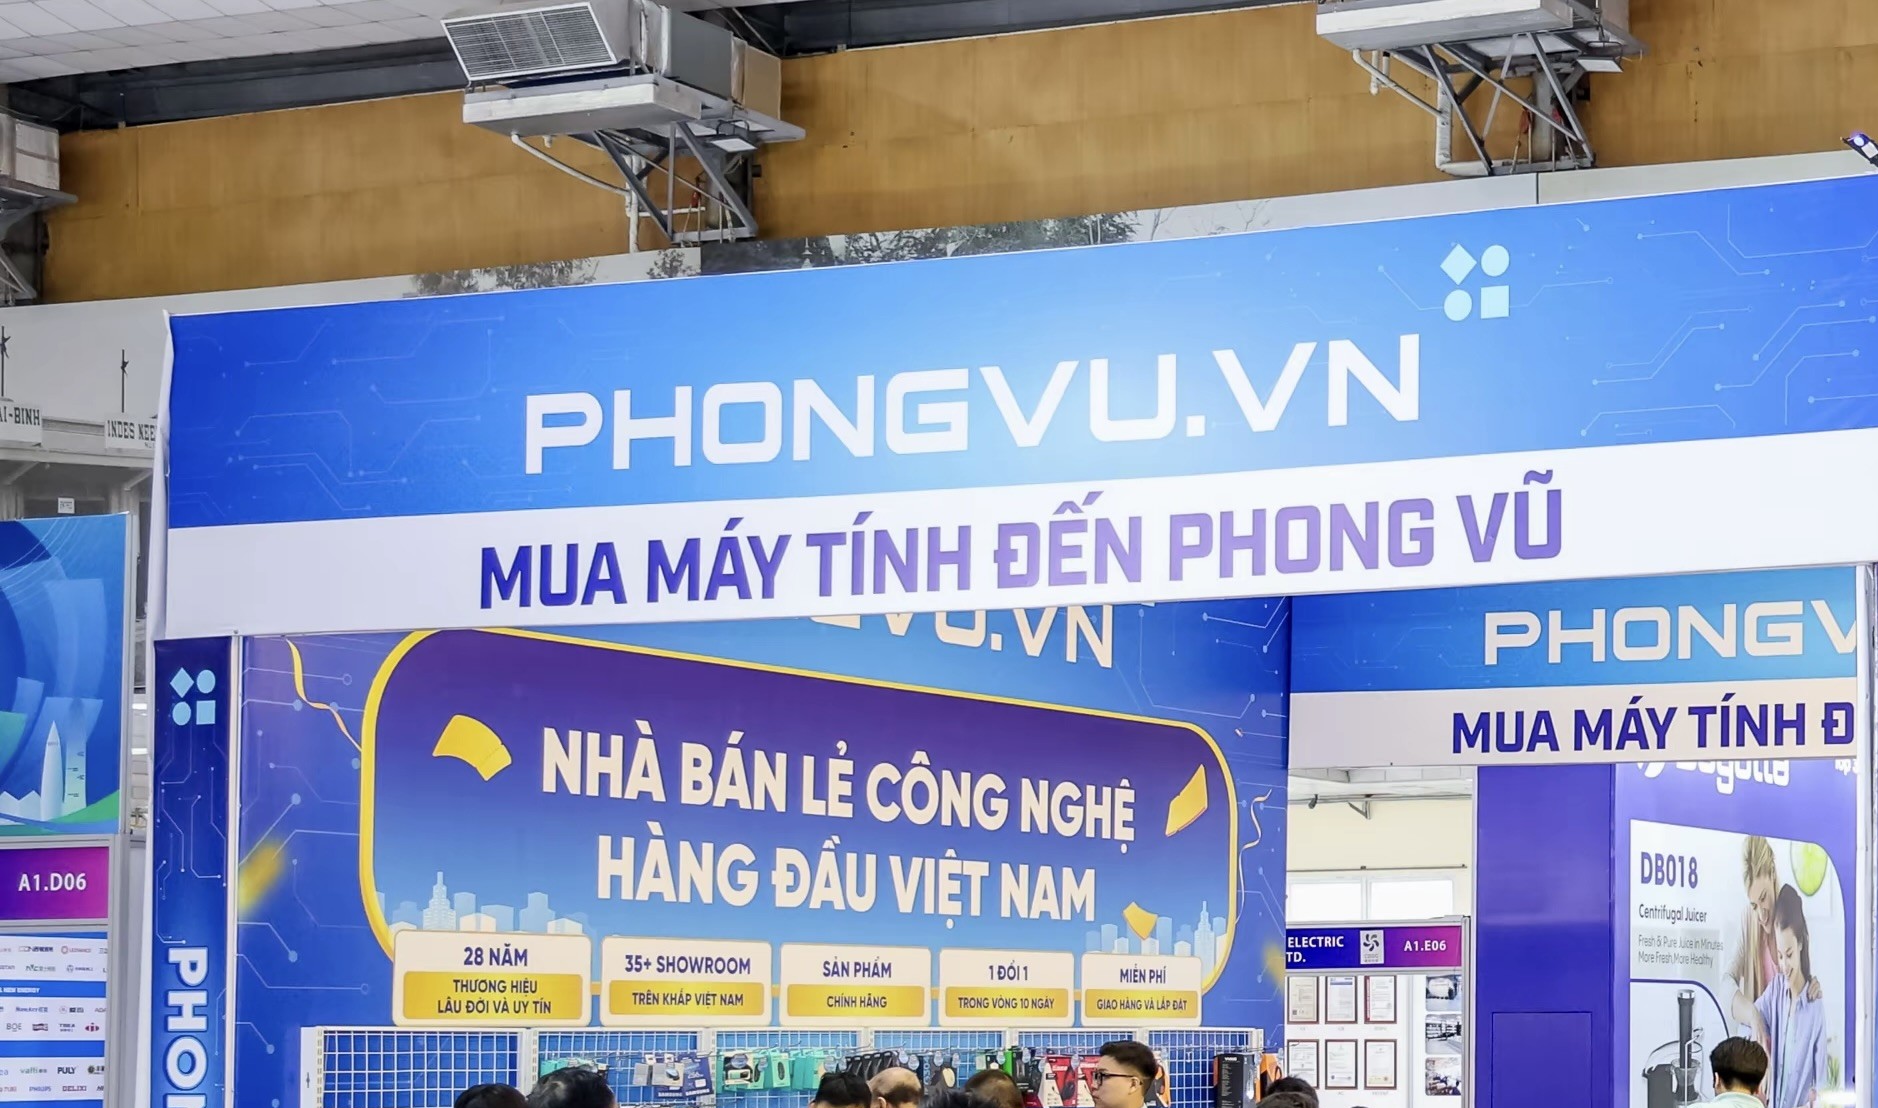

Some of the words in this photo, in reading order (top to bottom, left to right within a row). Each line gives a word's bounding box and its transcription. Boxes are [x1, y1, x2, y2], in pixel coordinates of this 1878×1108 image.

[525, 334, 1421, 475] PHONGVU.VN
[107, 419, 135, 440] INDES
[480, 543, 626, 611] MUA
[646, 516, 792, 603] MÁY
[806, 511, 972, 598] TÍNH
[993, 490, 1144, 590] ĐẾN
[1168, 497, 1434, 582] PHONG
[1456, 469, 1564, 563] VŨ
[1452, 710, 1561, 755] MUA
[1573, 695, 1678, 752] MÁY
[1688, 692, 1806, 749] TÍNH
[541, 718, 667, 804] NHÀ
[680, 730, 789, 814] BÁN
[801, 739, 855, 819] LẺ
[866, 750, 1010, 833] CÔNG
[1020, 778, 1137, 854] NGHỆ
[597, 820, 760, 908] HÀNG
[770, 834, 878, 914] ĐẦU
[888, 848, 990, 930] VIỆT
[1000, 861, 1097, 924] NAM
[1640, 851, 1699, 890] DB018
[17, 872, 88, 892] A1.D06
[1638, 904, 1684, 924] Centrifugal
[1684, 906, 1708, 923] Juicer
[1287, 935, 1345, 948] ELECTRIC
[1403, 940, 1447, 952] A1.E06
[1638, 934, 1656, 948] Fresh
[1663, 936, 1678, 949] Pure
[1678, 936, 1693, 950] Juice
[1701, 937, 1724, 951] Minutes
[463, 946, 484, 966] 28
[489, 942, 529, 967] NĂM
[624, 954, 653, 974] 35+
[655, 954, 752, 975] SHOWROOM
[1638, 952, 1655, 964] More
[1690, 954, 1714, 968] Healthy
[822, 955, 851, 978] SẢN
[853, 953, 893, 979] PHẨM
[988, 965, 996, 981] 1
[997, 960, 1021, 982] ĐỔI
[1022, 965, 1029, 981] 1
[1119, 963, 1147, 985] MIỄN
[1147, 966, 1167, 985] PHÍ
[453, 978, 508, 995] THƯƠNG
[511, 978, 539, 996] HIỆU
[437, 998, 463, 1014] LÂU
[465, 997, 490, 1015] ĐỜI
[492, 997, 512, 1014] VÀ
[512, 999, 532, 1015] UY
[534, 997, 552, 1015] TÍN
[631, 990, 662, 1006] TRÊN
[664, 988, 693, 1007] KHẮP
[694, 990, 718, 1008] VIỆT
[720, 992, 744, 1007] NAM
[826, 992, 857, 1009] CHÍNH
[958, 995, 990, 1010] TRONG
[990, 993, 1018, 1011] VÒNG
[1019, 996, 1029, 1010] 10
[1030, 993, 1056, 1011] NGÀY
[1096, 998, 1118, 1012] GIAO
[1119, 997, 1143, 1012] HÀNG
[1143, 996, 1156, 1012] VÀ
[1156, 995, 1172, 1012] LẮP
[1172, 995, 1188, 1013] ĐẶT
